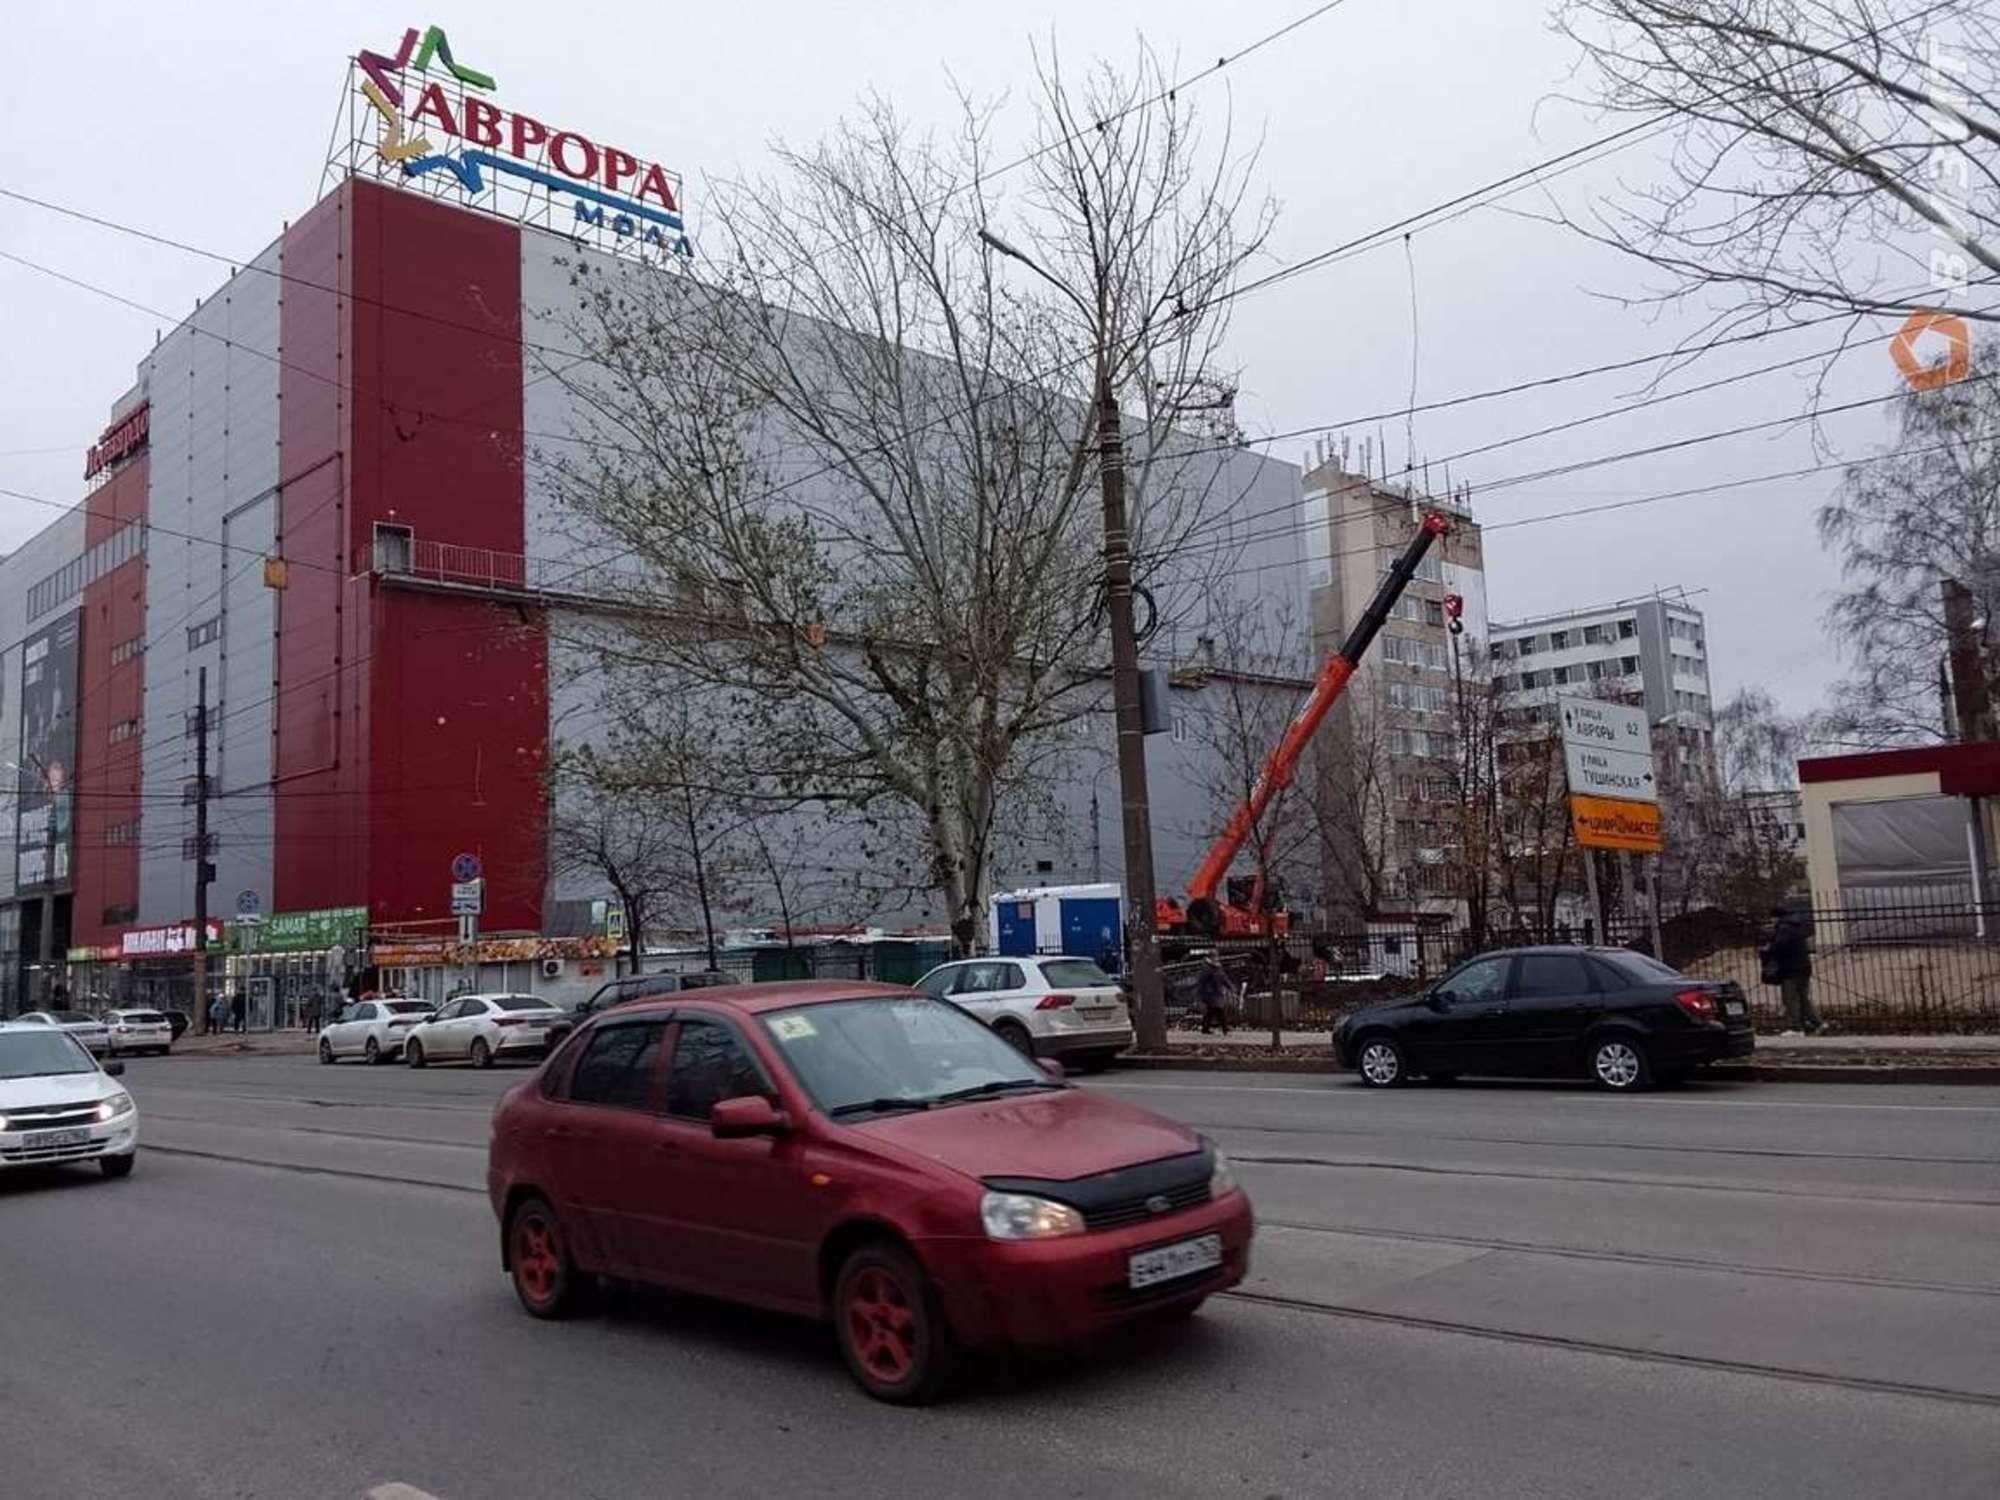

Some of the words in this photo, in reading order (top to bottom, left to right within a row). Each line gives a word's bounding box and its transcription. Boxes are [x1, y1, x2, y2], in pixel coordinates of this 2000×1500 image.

[409, 82, 678, 213] АВРОРА
[1577, 721, 1615, 740] АВРОРЫ
[1583, 769, 1640, 788] ТУШИНСКАЯ
